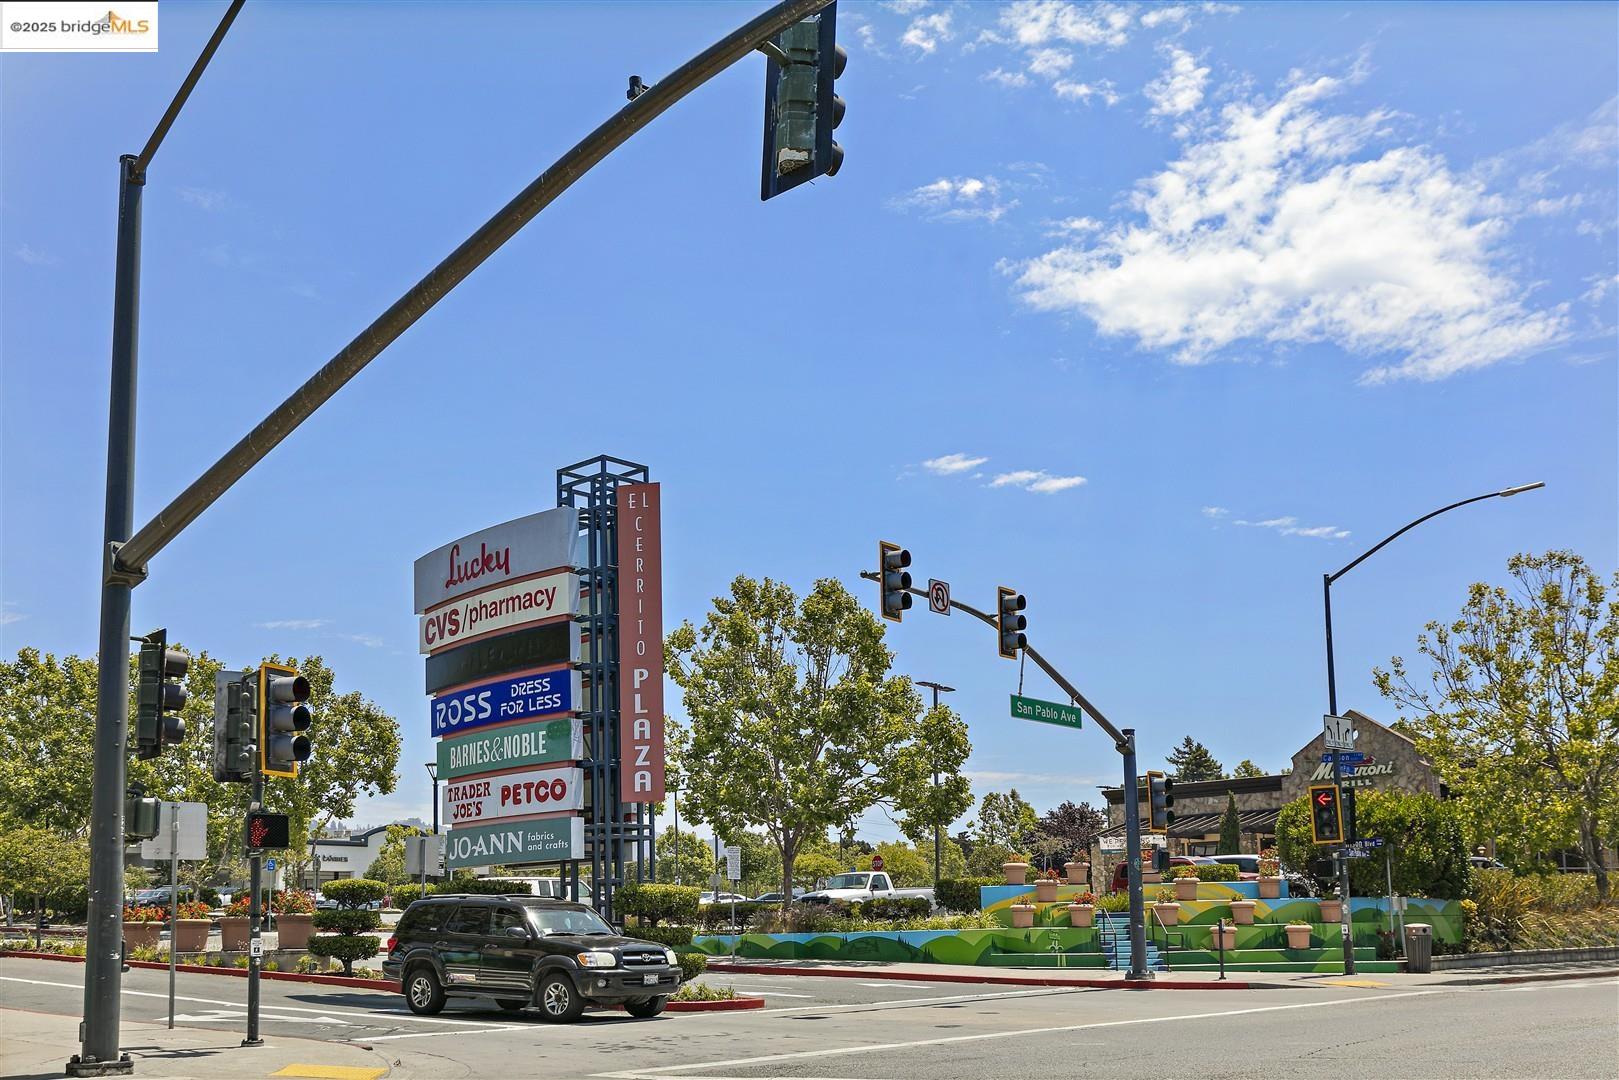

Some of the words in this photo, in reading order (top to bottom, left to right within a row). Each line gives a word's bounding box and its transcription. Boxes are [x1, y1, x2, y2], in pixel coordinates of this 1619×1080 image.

[628, 491, 649, 509] EL
[445, 542, 510, 589] Lucky
[634, 516, 646, 657] CERRITO
[424, 586, 557, 645] CVS/pharmacy
[511, 677, 551, 698] DRESS
[436, 690, 492, 729] ROSS
[500, 702, 524, 717] FOR
[528, 693, 562, 712] LESS
[1016, 701, 1033, 715] San
[1035, 704, 1058, 720] Pablo
[1060, 709, 1077, 723] Ave
[633, 668, 651, 793] PLAZA
[1323, 754, 1350, 762] Caon
[1311, 761, 1393, 781] Mroni
[447, 780, 491, 803] TRADER
[500, 777, 567, 807] PETCO
[1341, 779, 1372, 787] RILL
[452, 800, 483, 820] JOE'S
[527, 831, 555, 841] fabrics
[527, 841, 543, 851] and
[545, 839, 569, 850] crafts
